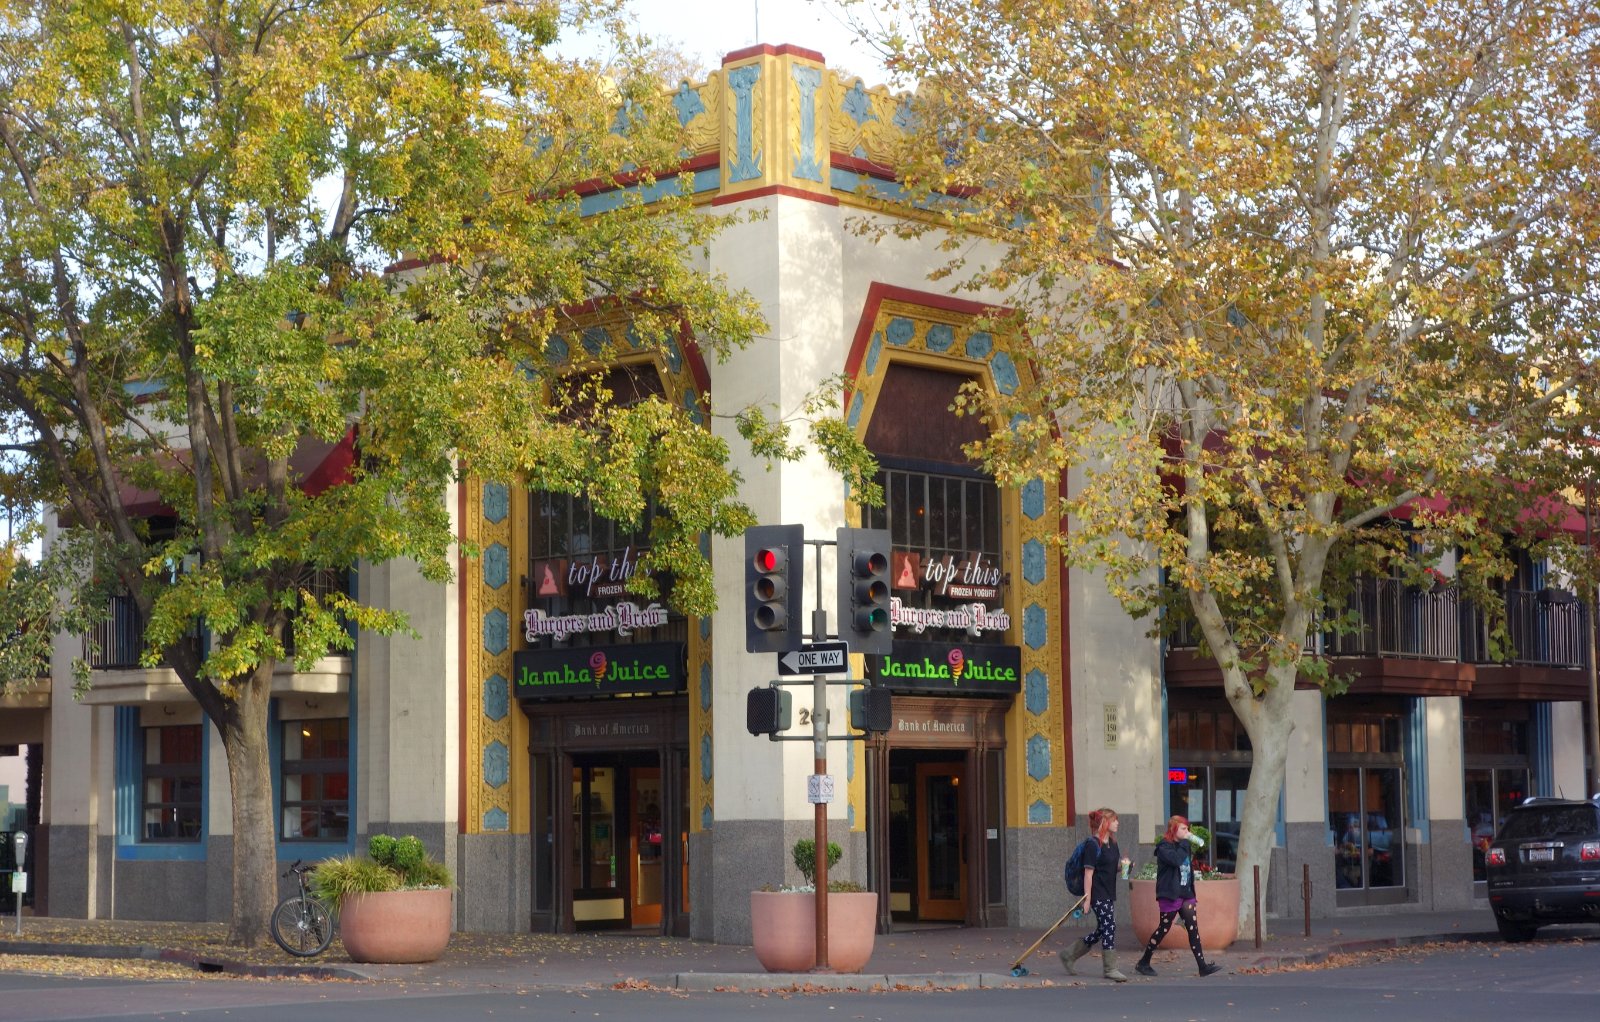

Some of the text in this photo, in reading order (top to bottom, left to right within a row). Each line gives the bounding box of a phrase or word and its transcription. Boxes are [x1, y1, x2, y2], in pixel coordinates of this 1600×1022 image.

[569, 556, 603, 597] top
[925, 552, 1001, 595] top this
[598, 585, 623, 596] FROZEN
[951, 587, 996, 598] FROZEN YOGURT
[524, 602, 662, 643] Burgers and Brew
[890, 596, 1011, 637] Burgers and Brew
[799, 652, 839, 666] ONE WAY
[518, 660, 670, 686] Jamba Juice
[881, 656, 1017, 681] Jamba Juice
[1106, 713, 1117, 722] 100
[574, 722, 649, 738] Bank of America
[898, 719, 965, 732] Bank of America
[1106, 723, 1117, 732] 150
[1106, 733, 1117, 742] 200
[1168, 771, 1185, 780] PEN
